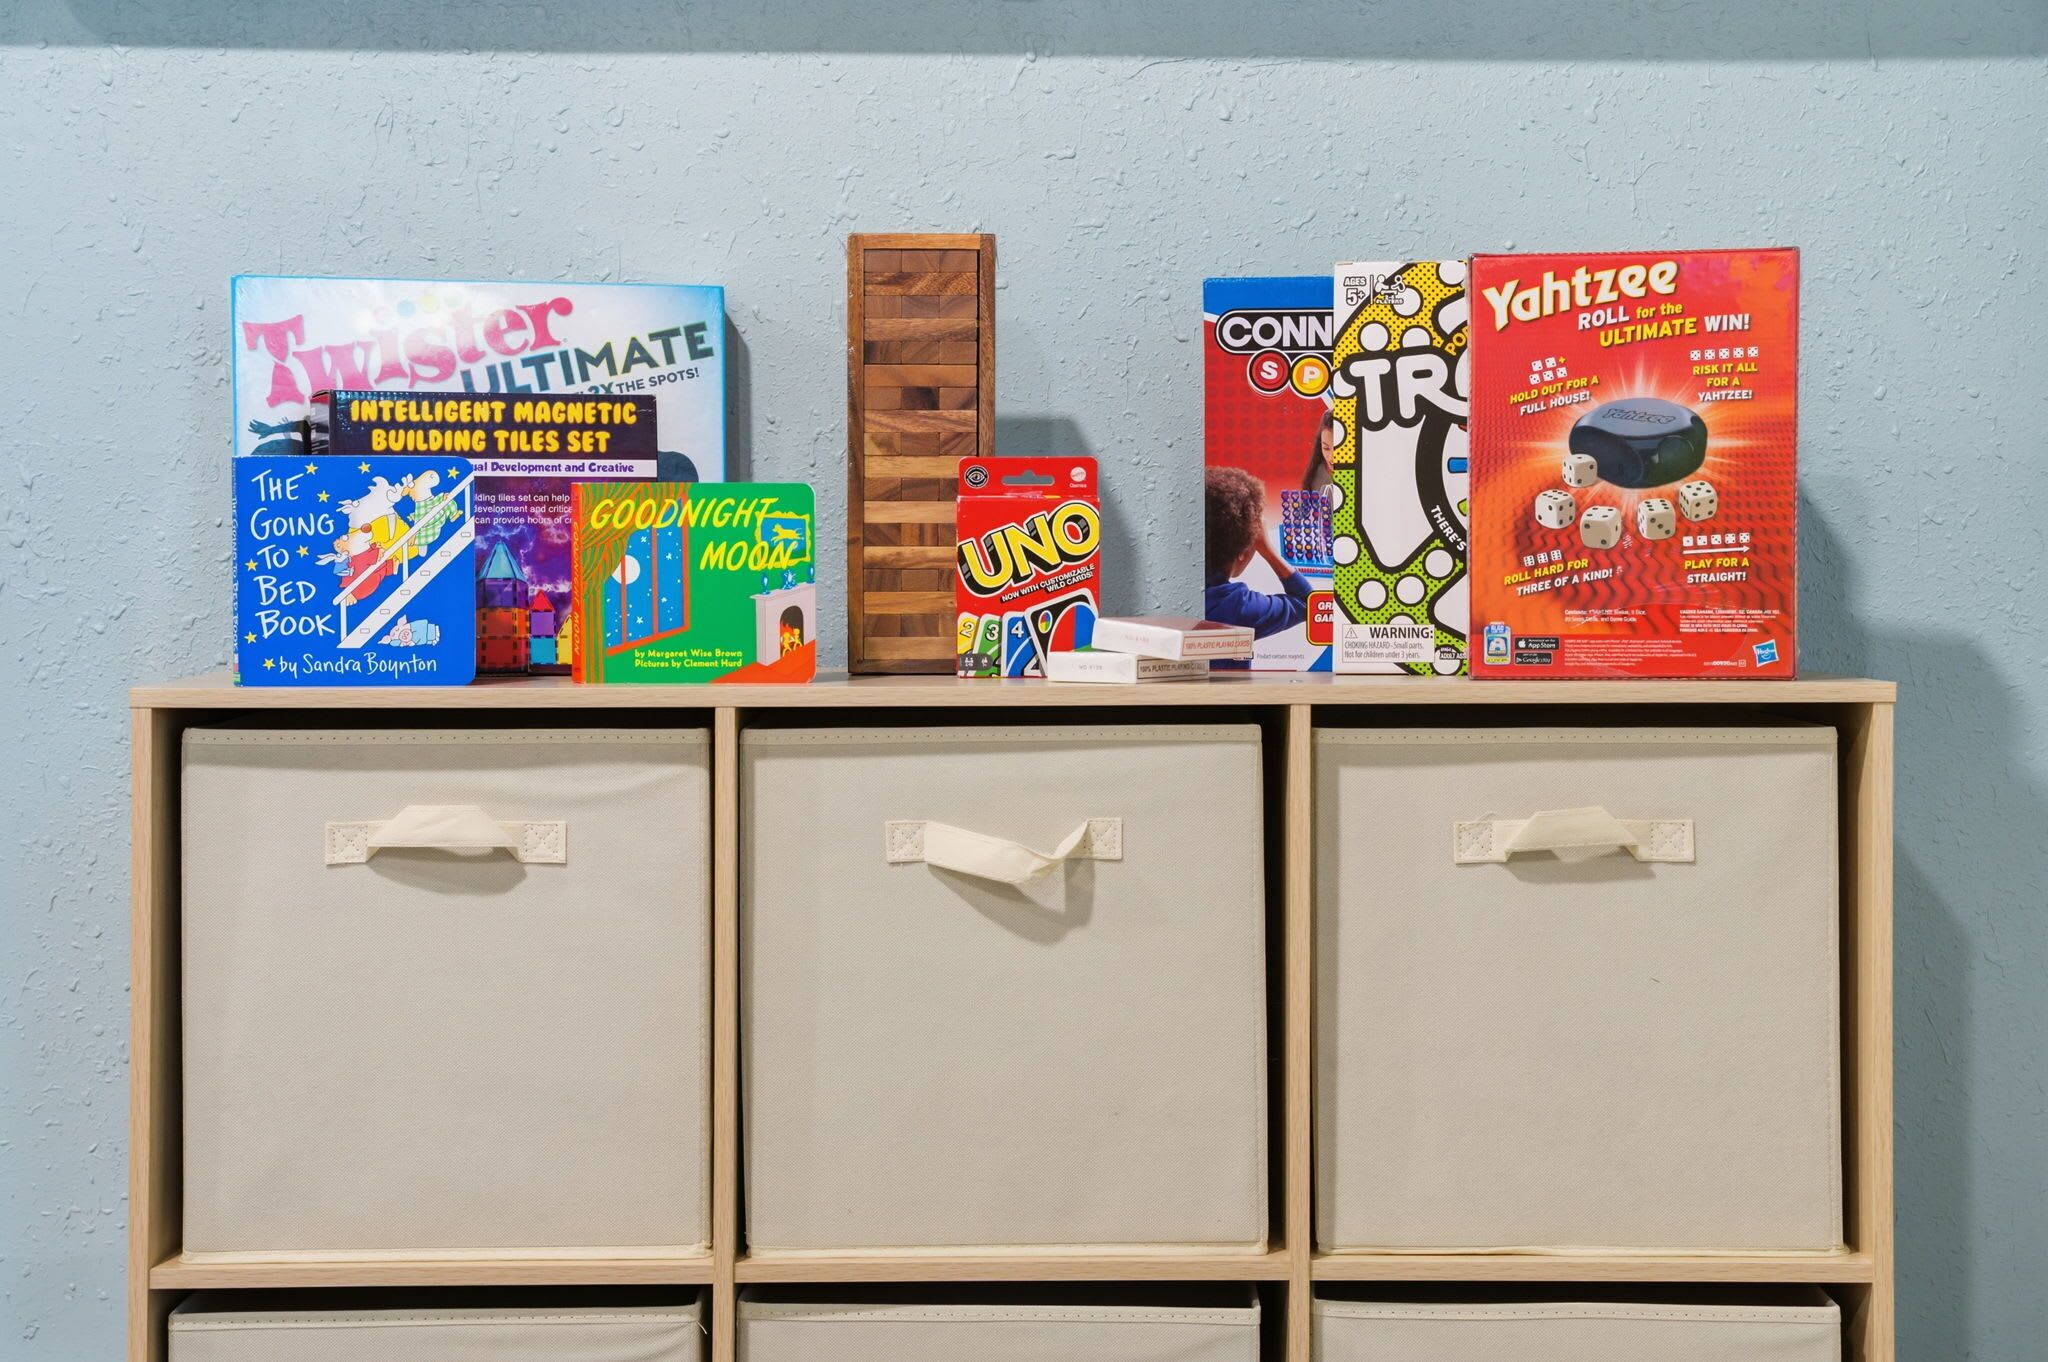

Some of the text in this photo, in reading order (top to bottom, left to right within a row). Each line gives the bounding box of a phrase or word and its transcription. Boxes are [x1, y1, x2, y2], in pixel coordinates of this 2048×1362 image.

[1344, 276, 1367, 286] AGES
[1346, 288, 1366, 306] 5+
[1481, 260, 1679, 332] Yahtzee
[1578, 302, 1683, 331] ROLL for the
[1222, 316, 1332, 348] CONN
[1599, 313, 1750, 347] ULTIMATE WIN!
[243, 296, 574, 408] Twister
[460, 321, 715, 394] ULTIMATE
[616, 379, 646, 394] THE
[649, 367, 700, 387] SPOTS!
[1692, 362, 1758, 375] RISK IT ALL
[1510, 375, 1599, 404] HOLD OUT FOR A
[1706, 376, 1740, 387] FOR A
[1520, 391, 1590, 416] FULL HOUSE!
[1697, 389, 1753, 401] YAHTZEE!
[351, 400, 637, 425] INTELLIGENT MAGNETIC
[1602, 408, 1677, 425] Yahtzee
[371, 428, 611, 452] BUILDING TILES SET
[491, 462, 562, 474] Development
[565, 462, 581, 472] and
[584, 462, 635, 472] Creative
[252, 469, 304, 502] THE
[498, 493, 516, 502] tiles
[518, 493, 531, 502] set
[533, 494, 549, 502] can
[551, 493, 570, 503] help
[530, 504, 546, 513] and
[250, 508, 334, 541] GOING
[493, 515, 525, 526] provide
[528, 516, 552, 525] hours
[554, 515, 562, 524] of
[590, 497, 778, 530] GOODNIGHT
[257, 544, 290, 570] TO
[700, 540, 799, 571] MOON
[958, 502, 1099, 592] UNO
[1503, 558, 1588, 585] ROLL HARD FOR
[1684, 557, 1749, 569] PLAY FOR A
[1001, 563, 1095, 602] NOW WITH CUSTOMIZABLE
[1046, 571, 1094, 593] WILD CARDS!
[1516, 568, 1613, 596] THREE OF A KIND!
[1687, 571, 1746, 584] STRAIGHT!
[253, 575, 316, 606] BED
[255, 610, 336, 640] BOOK
[960, 621, 975, 638] 2
[985, 624, 999, 641] 3
[1011, 620, 1025, 638] 4
[1369, 627, 1433, 639] WARNING:
[635, 648, 742, 659] by Margaret Wise Brown
[1344, 641, 1368, 649] CHOKING
[1369, 641, 1390, 649] HAZARD
[1394, 641, 1407, 649] Small
[1409, 642, 1424, 650] parts.
[1406, 652, 1420, 660] years.
[280, 652, 437, 679] by Sandra Boynton
[635, 658, 743, 668] Pictures by Clement Hurd
[1152, 664, 1170, 672] PLASTIC
